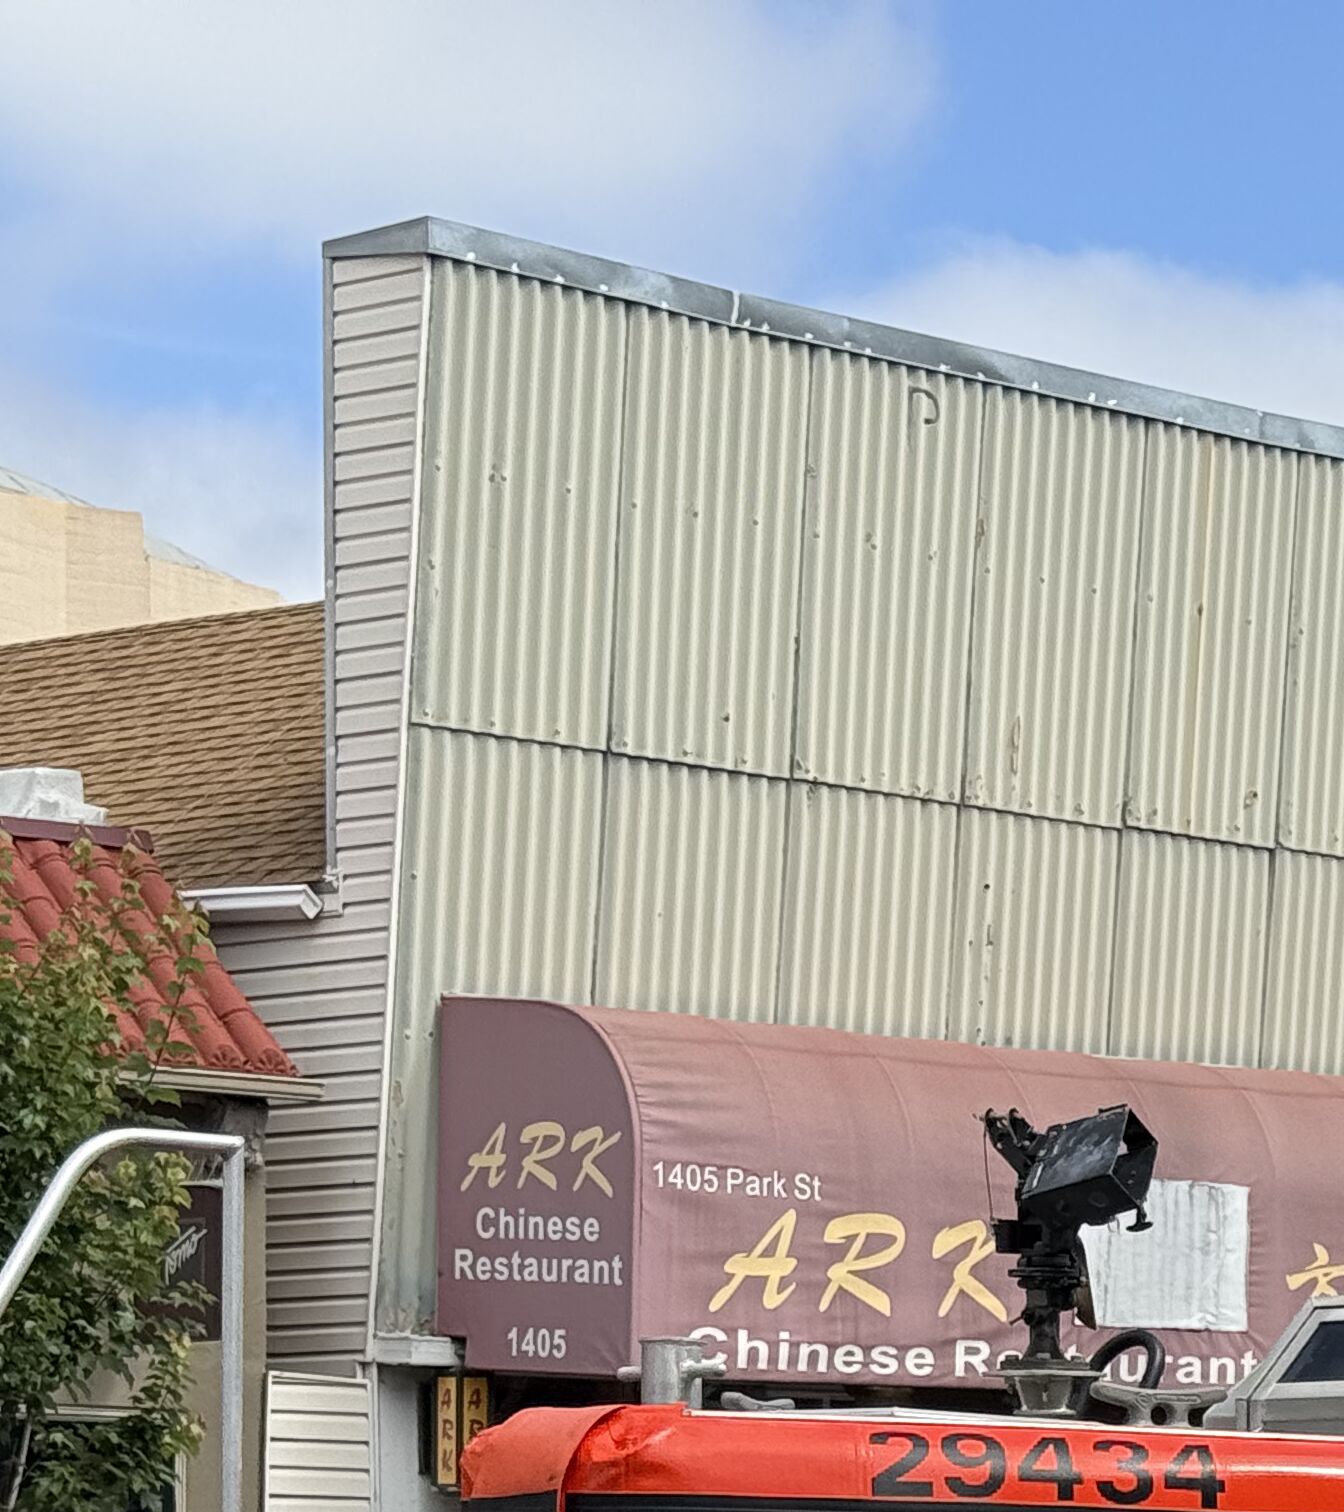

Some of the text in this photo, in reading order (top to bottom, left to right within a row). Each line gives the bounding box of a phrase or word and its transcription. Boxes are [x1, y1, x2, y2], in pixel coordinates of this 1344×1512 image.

[460, 1122, 622, 1198] ARK
[652, 1161, 822, 1202] 1405 Park St
[475, 1207, 600, 1241] Chinese
[454, 1248, 624, 1286] Restaurant
[709, 1209, 1008, 1323] ARK
[507, 1327, 567, 1360] 1405
[689, 1326, 936, 1377] Chinese
[870, 1432, 1226, 1511] 29434
